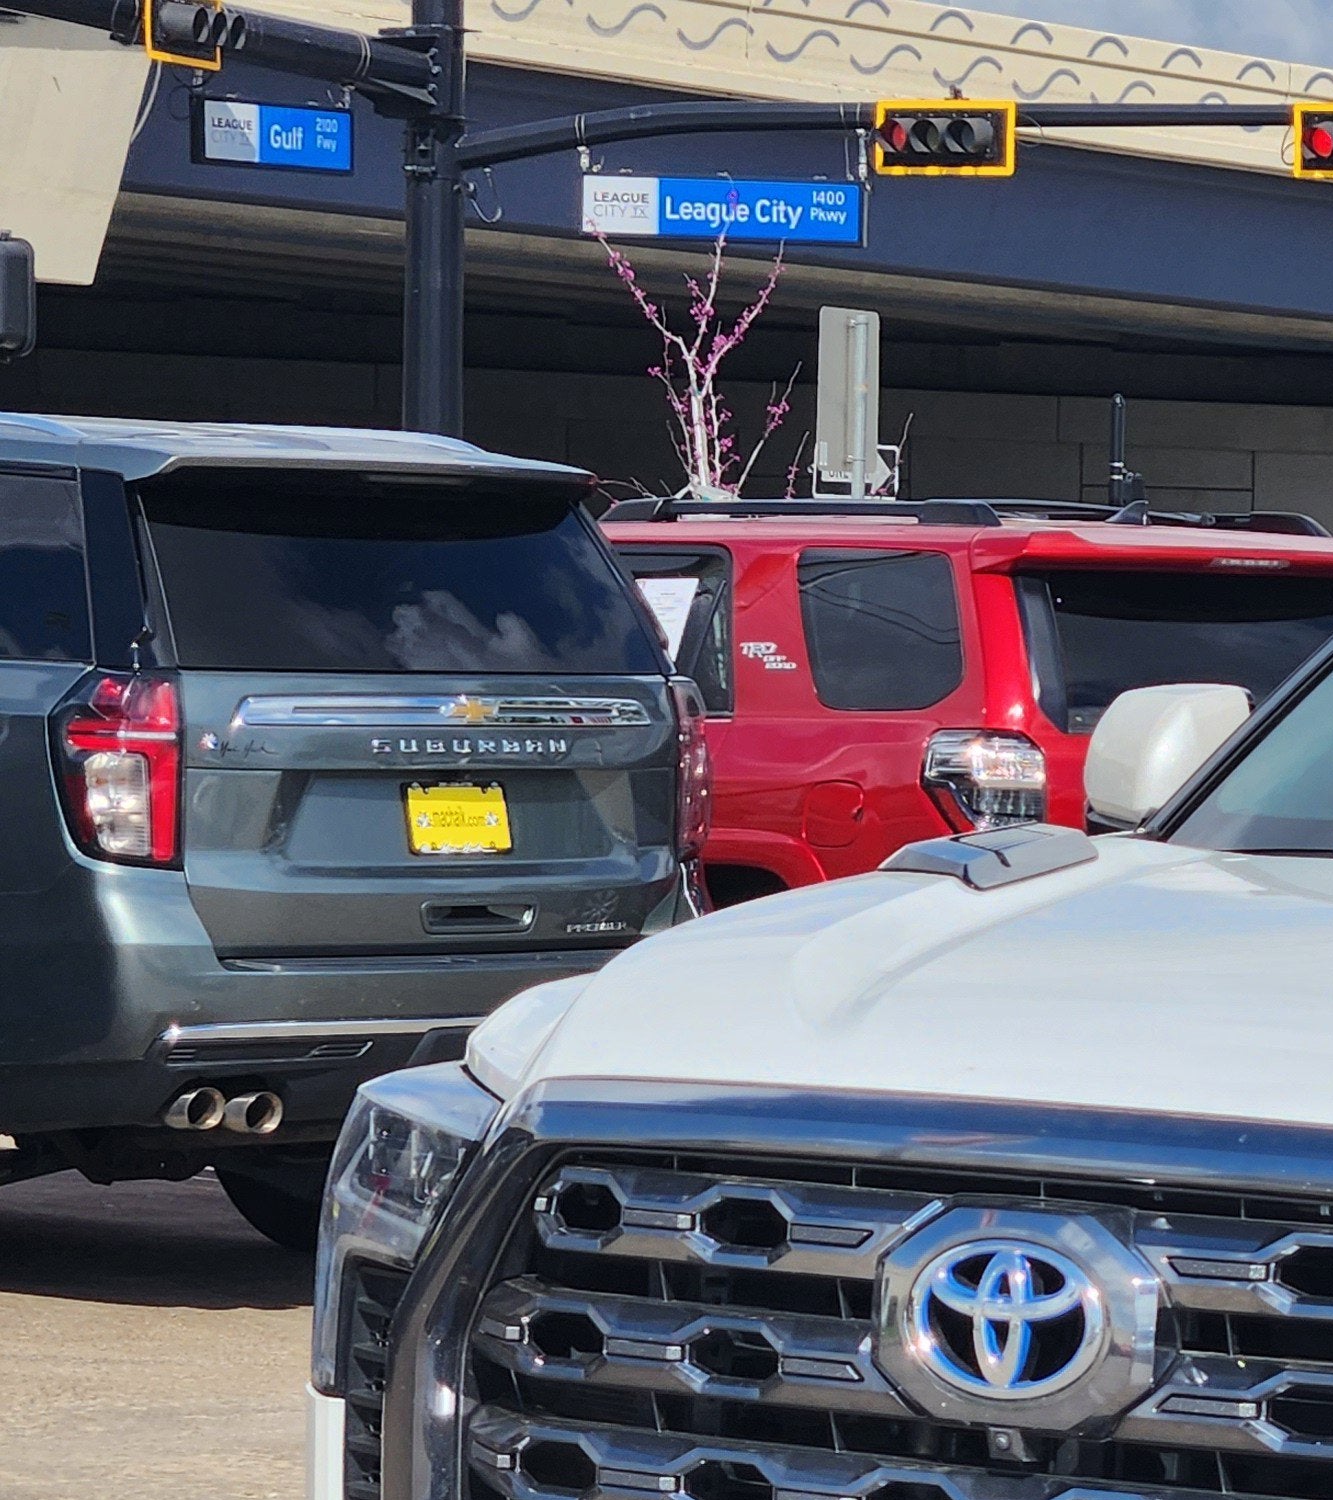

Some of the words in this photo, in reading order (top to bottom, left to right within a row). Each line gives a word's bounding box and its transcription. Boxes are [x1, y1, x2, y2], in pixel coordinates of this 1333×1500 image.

[211, 117, 253, 131] LEAGUE
[315, 117, 339, 133] 2100
[269, 124, 304, 151] Gulf
[316, 135, 338, 153] Fwy
[593, 191, 650, 204] LEAGUE
[812, 190, 846, 206] 1400
[593, 204, 627, 218] CITY
[665, 195, 750, 229] League
[755, 198, 804, 230] City
[809, 207, 848, 226] Pkwy
[370, 738, 568, 754] SUBURBAN
